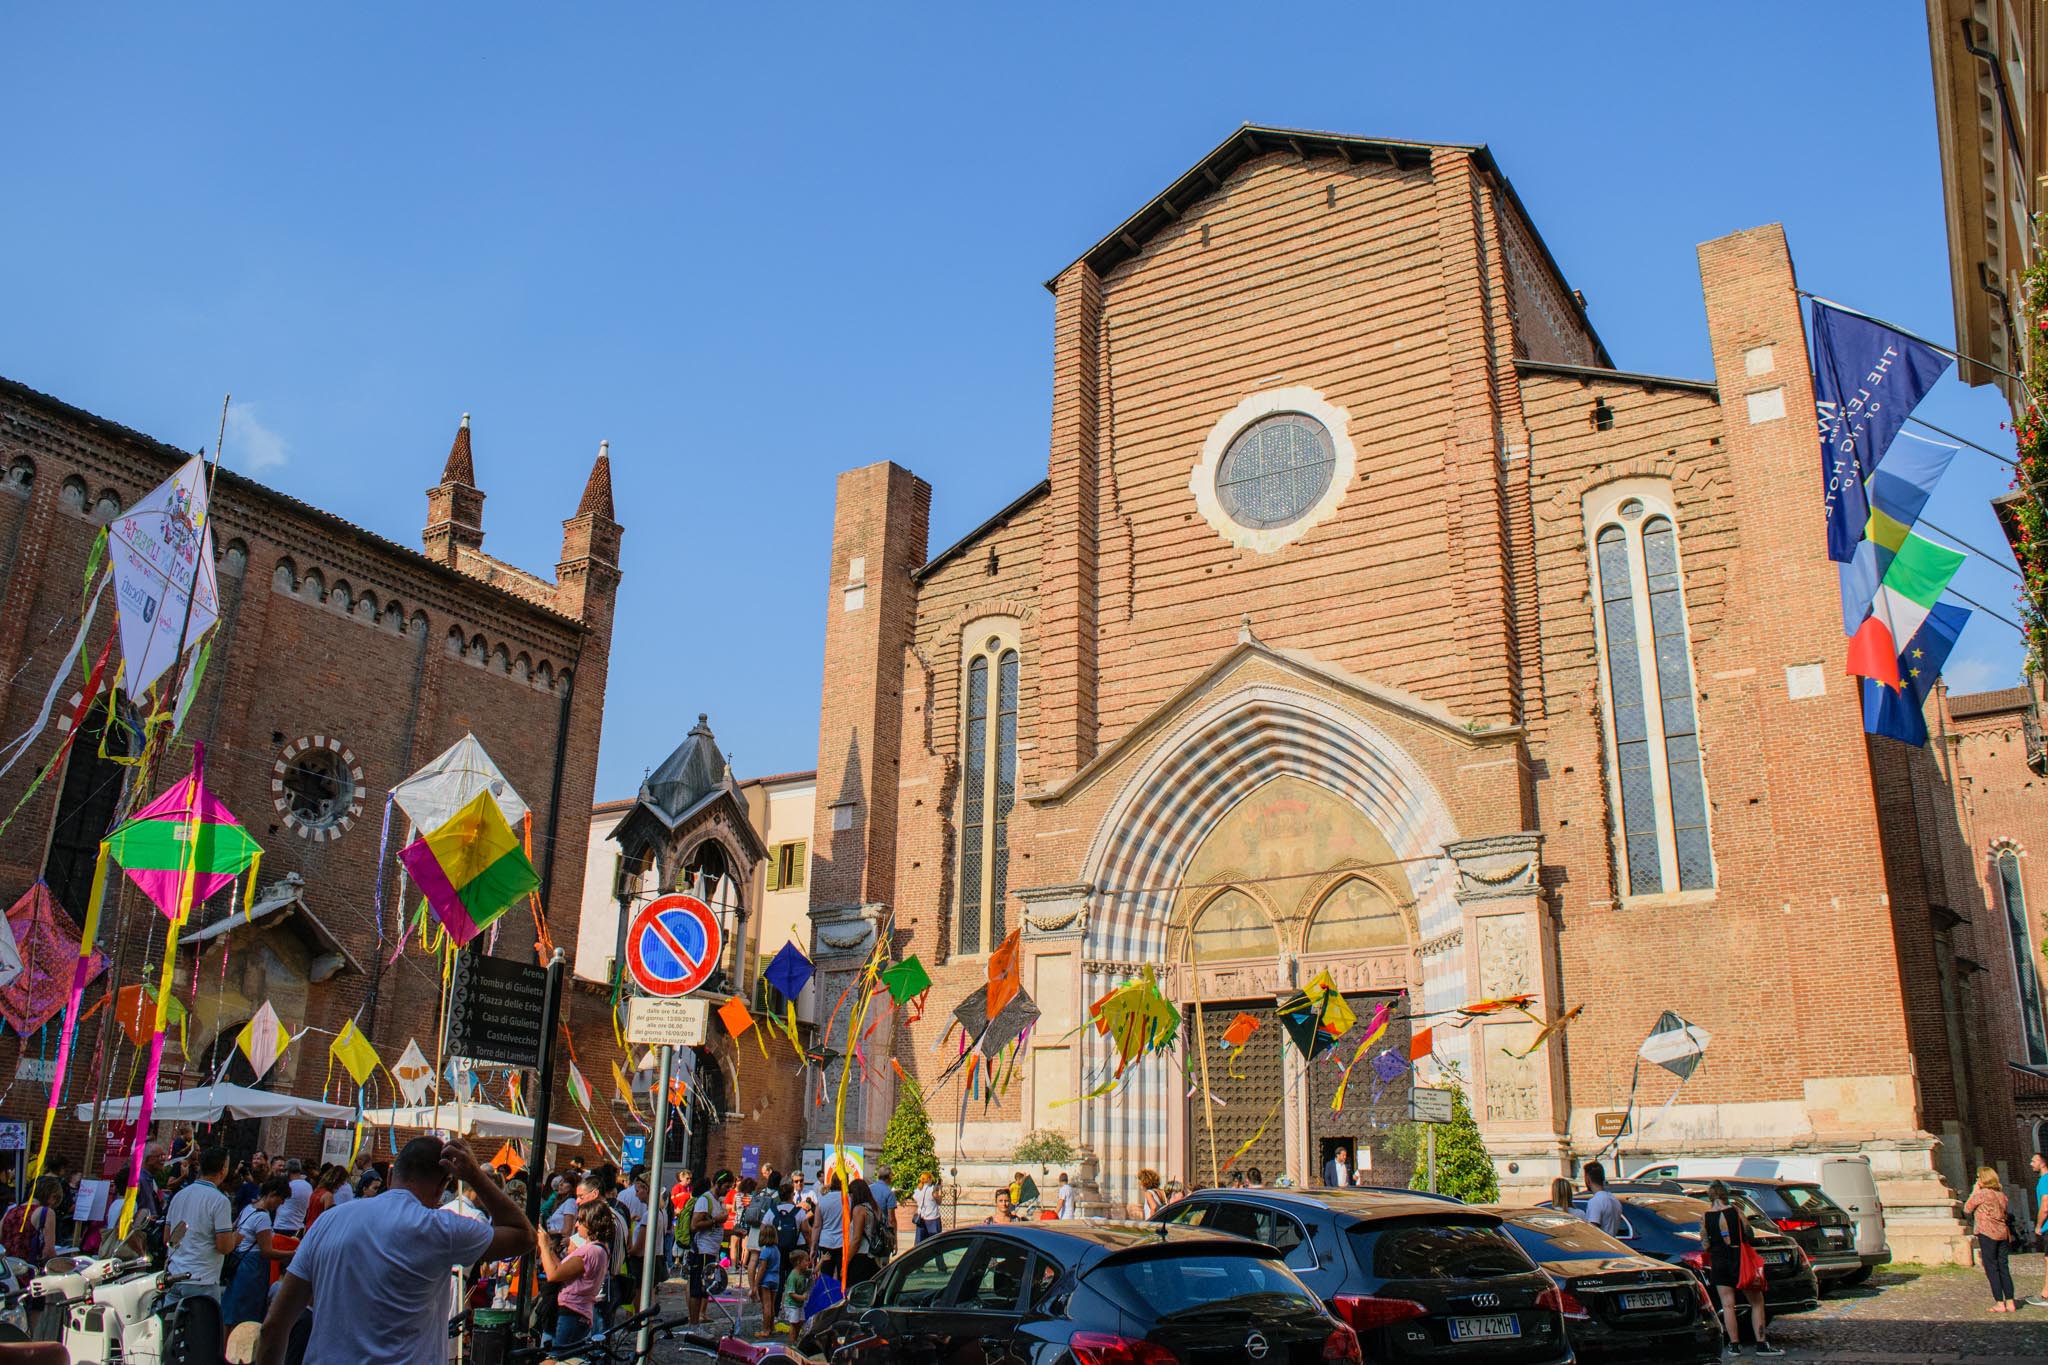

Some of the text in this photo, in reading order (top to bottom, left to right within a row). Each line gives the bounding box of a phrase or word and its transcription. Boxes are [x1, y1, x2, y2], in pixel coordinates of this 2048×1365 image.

[522, 967, 545, 980] Arena
[480, 976, 544, 997] Tomba di Giulietta
[479, 993, 542, 1013] Piazza delle Erbe
[482, 1012, 540, 1030] Casa di Giulietta
[486, 1030, 538, 1046] Castelvecchio
[476, 1045, 494, 1056] Torre
[507, 1049, 537, 1063] Lamberti
[1626, 1295, 1637, 1308] FF
